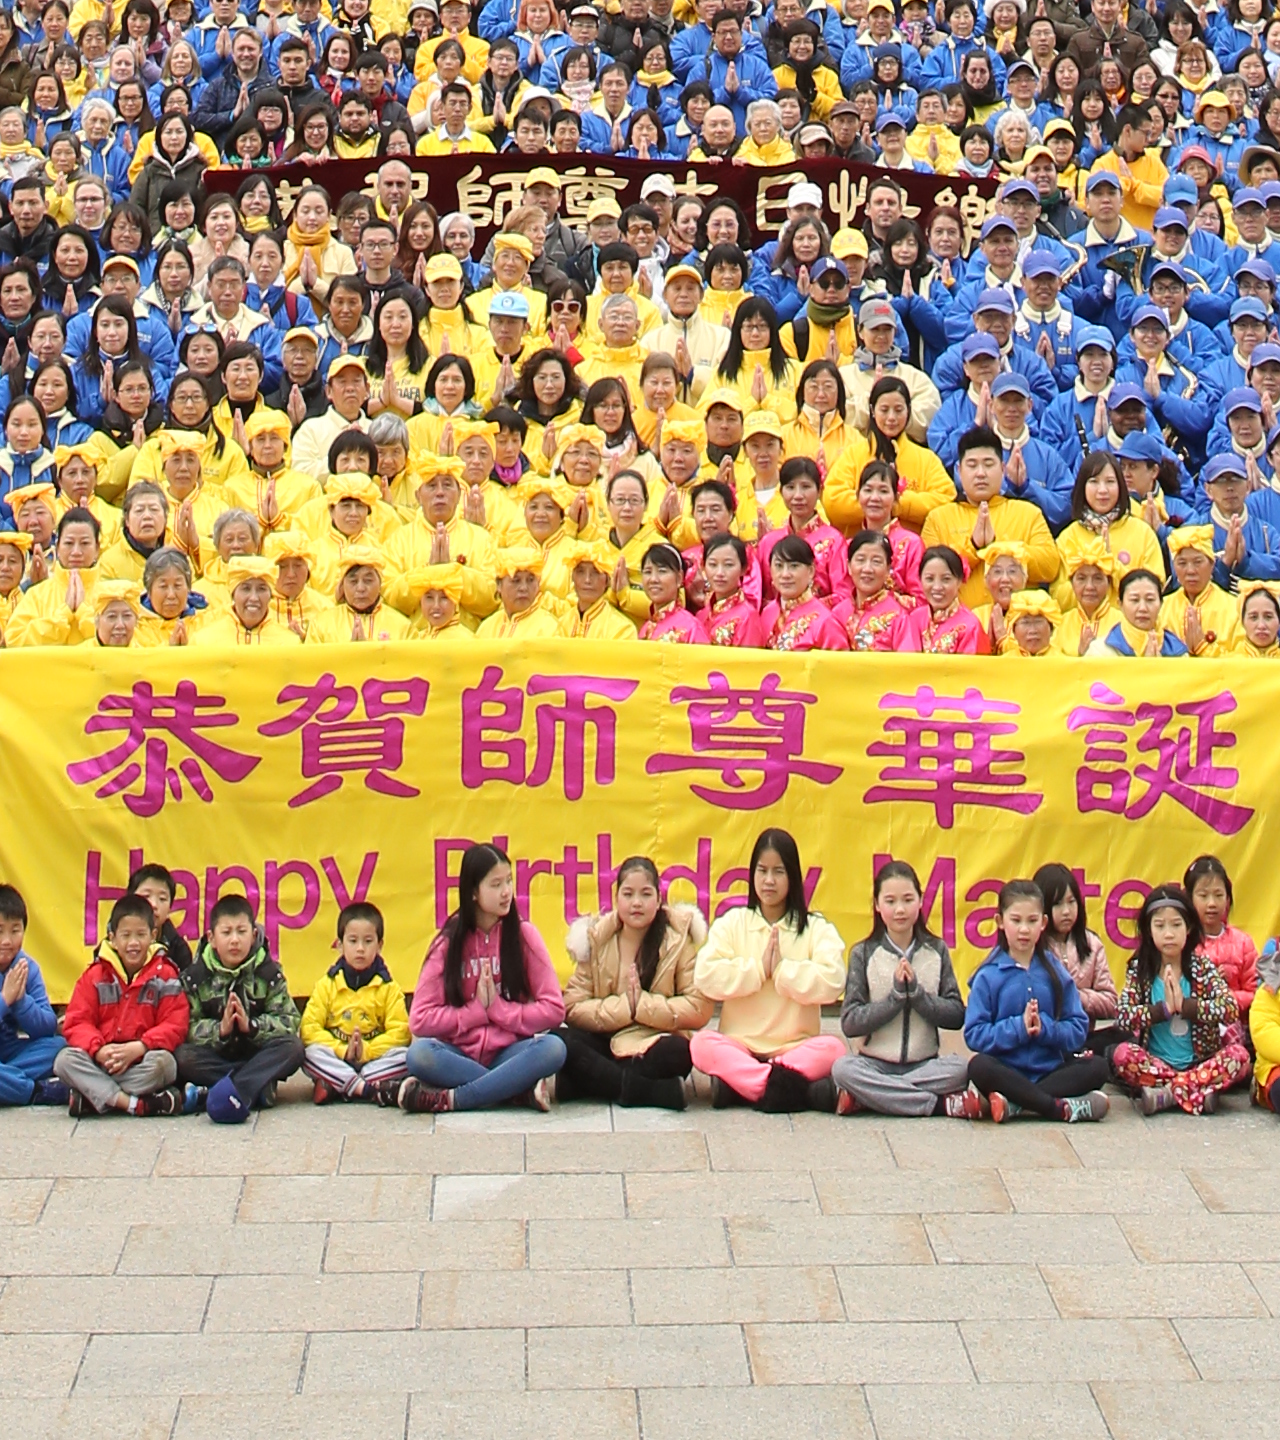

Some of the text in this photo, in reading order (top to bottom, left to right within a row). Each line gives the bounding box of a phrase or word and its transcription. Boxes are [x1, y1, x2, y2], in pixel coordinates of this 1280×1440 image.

[66, 666, 1255, 835] 恭賀師尊華誕
[84, 833, 1186, 962] Happy Brthda Mate
